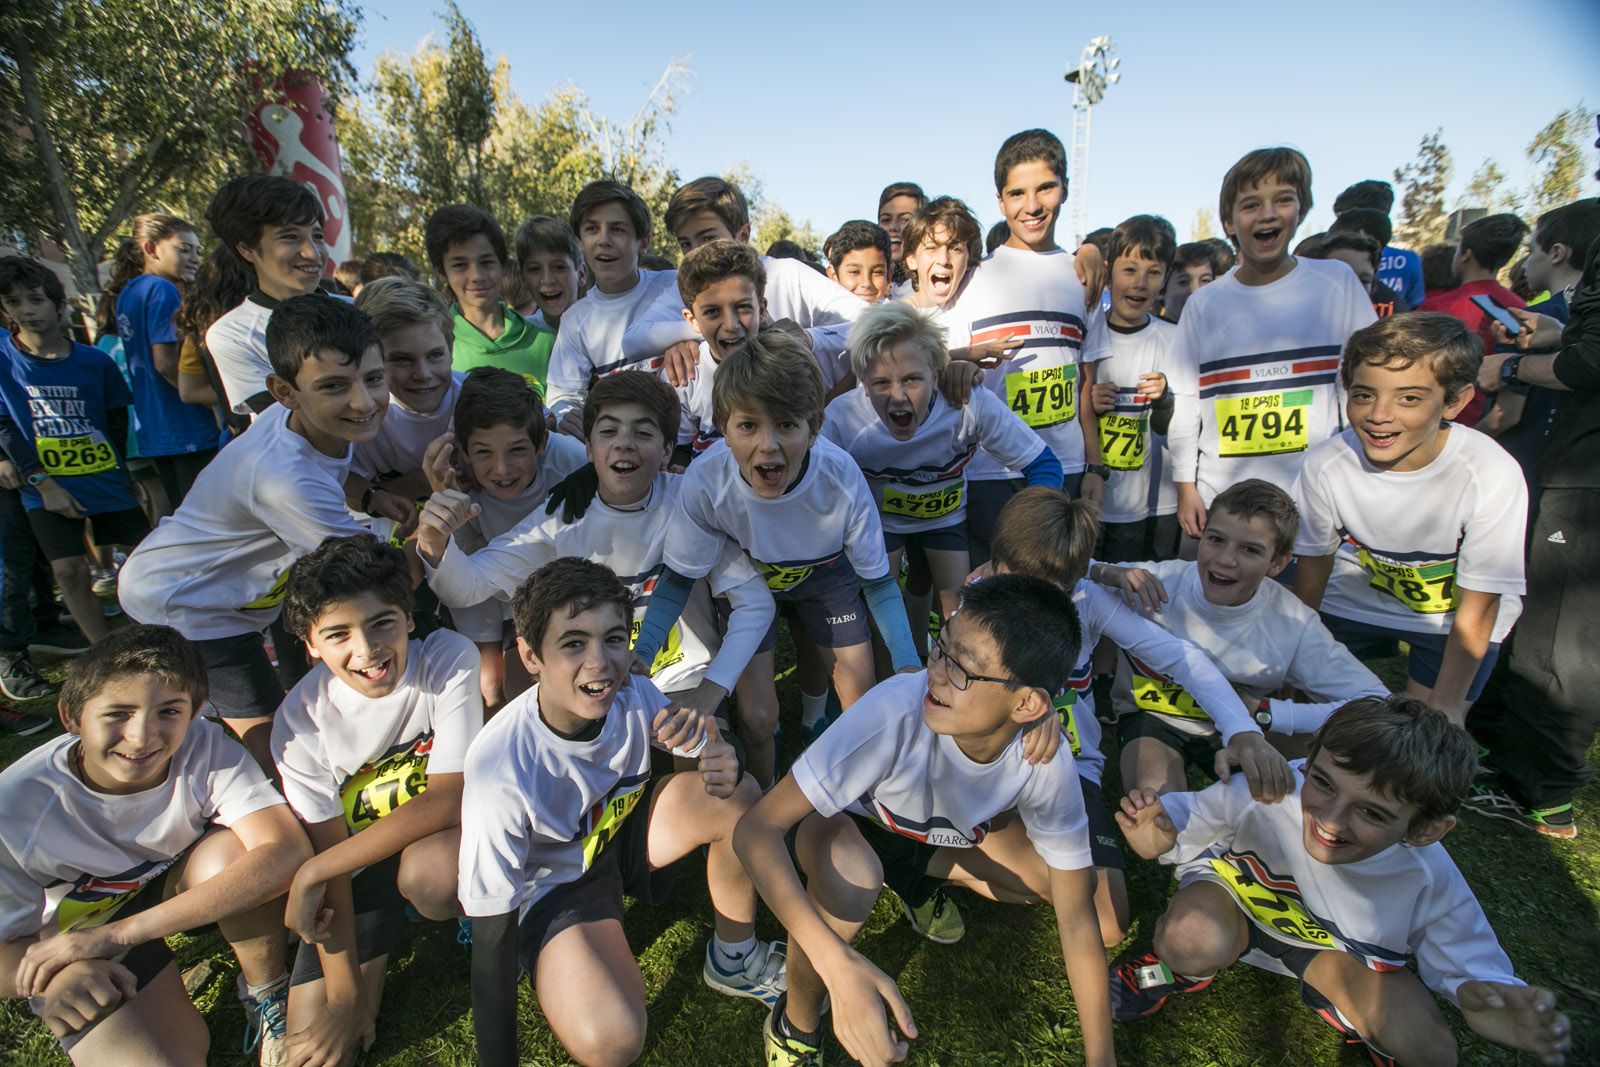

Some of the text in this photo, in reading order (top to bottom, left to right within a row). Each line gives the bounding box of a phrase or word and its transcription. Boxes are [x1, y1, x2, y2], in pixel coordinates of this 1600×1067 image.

[1255, 364, 1289, 378] VIARÓ
[1012, 381, 1073, 415] 4790
[1241, 398, 1250, 410] 19
[1222, 408, 1303, 441] 4794
[1102, 430, 1144, 457] 779
[43, 443, 111, 468] 0263
[887, 490, 959, 513] 4796
[826, 612, 857, 625] VIARÓ
[612, 798, 625, 818] 19
